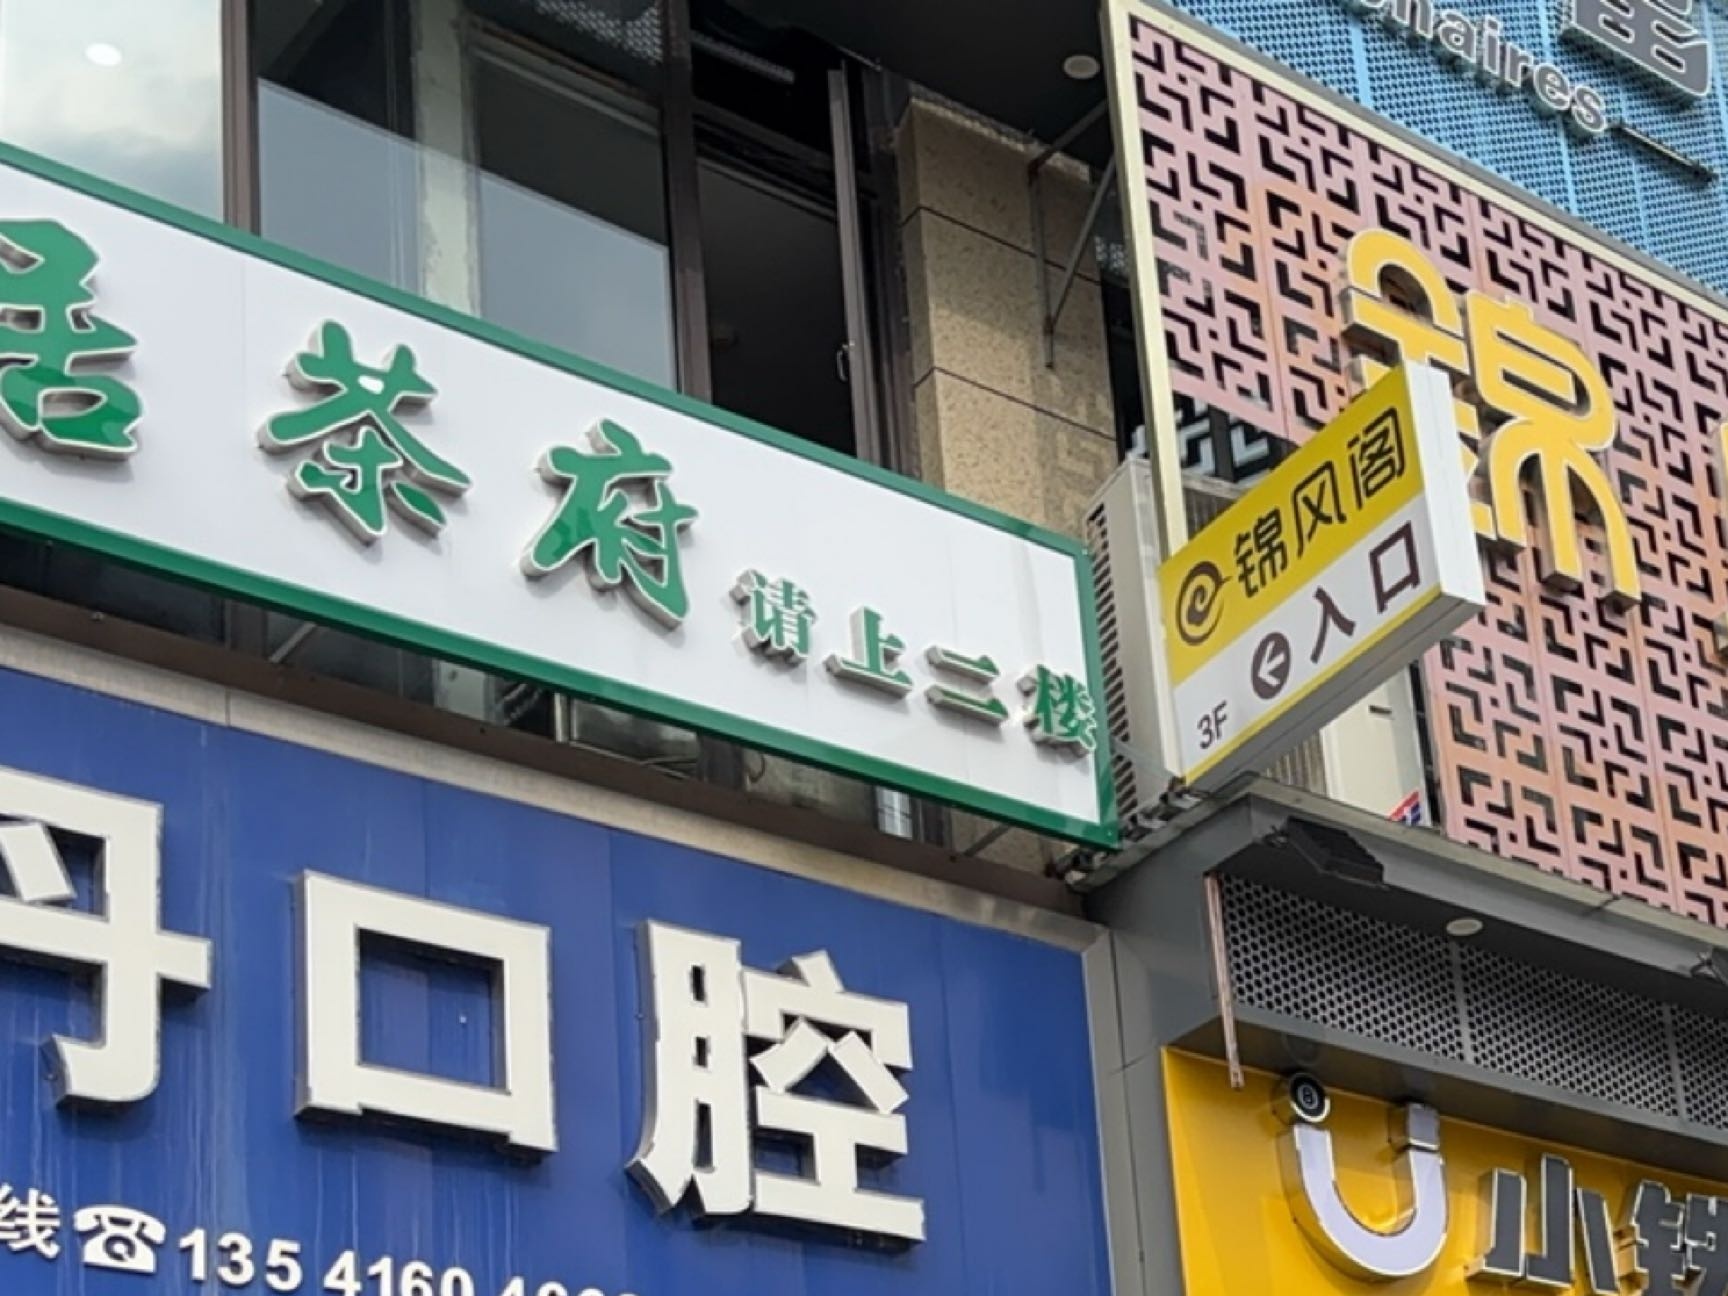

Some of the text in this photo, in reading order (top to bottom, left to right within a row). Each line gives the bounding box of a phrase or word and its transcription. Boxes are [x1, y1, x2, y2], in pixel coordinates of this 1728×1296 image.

[1360, 0, 1608, 133] naires
[1234, 408, 1406, 598] 锦风阁
[730, 569, 1097, 755] 请上二楼
[1197, 520, 1421, 750] 3F 入口
[178, 1229, 303, 1296] 135
